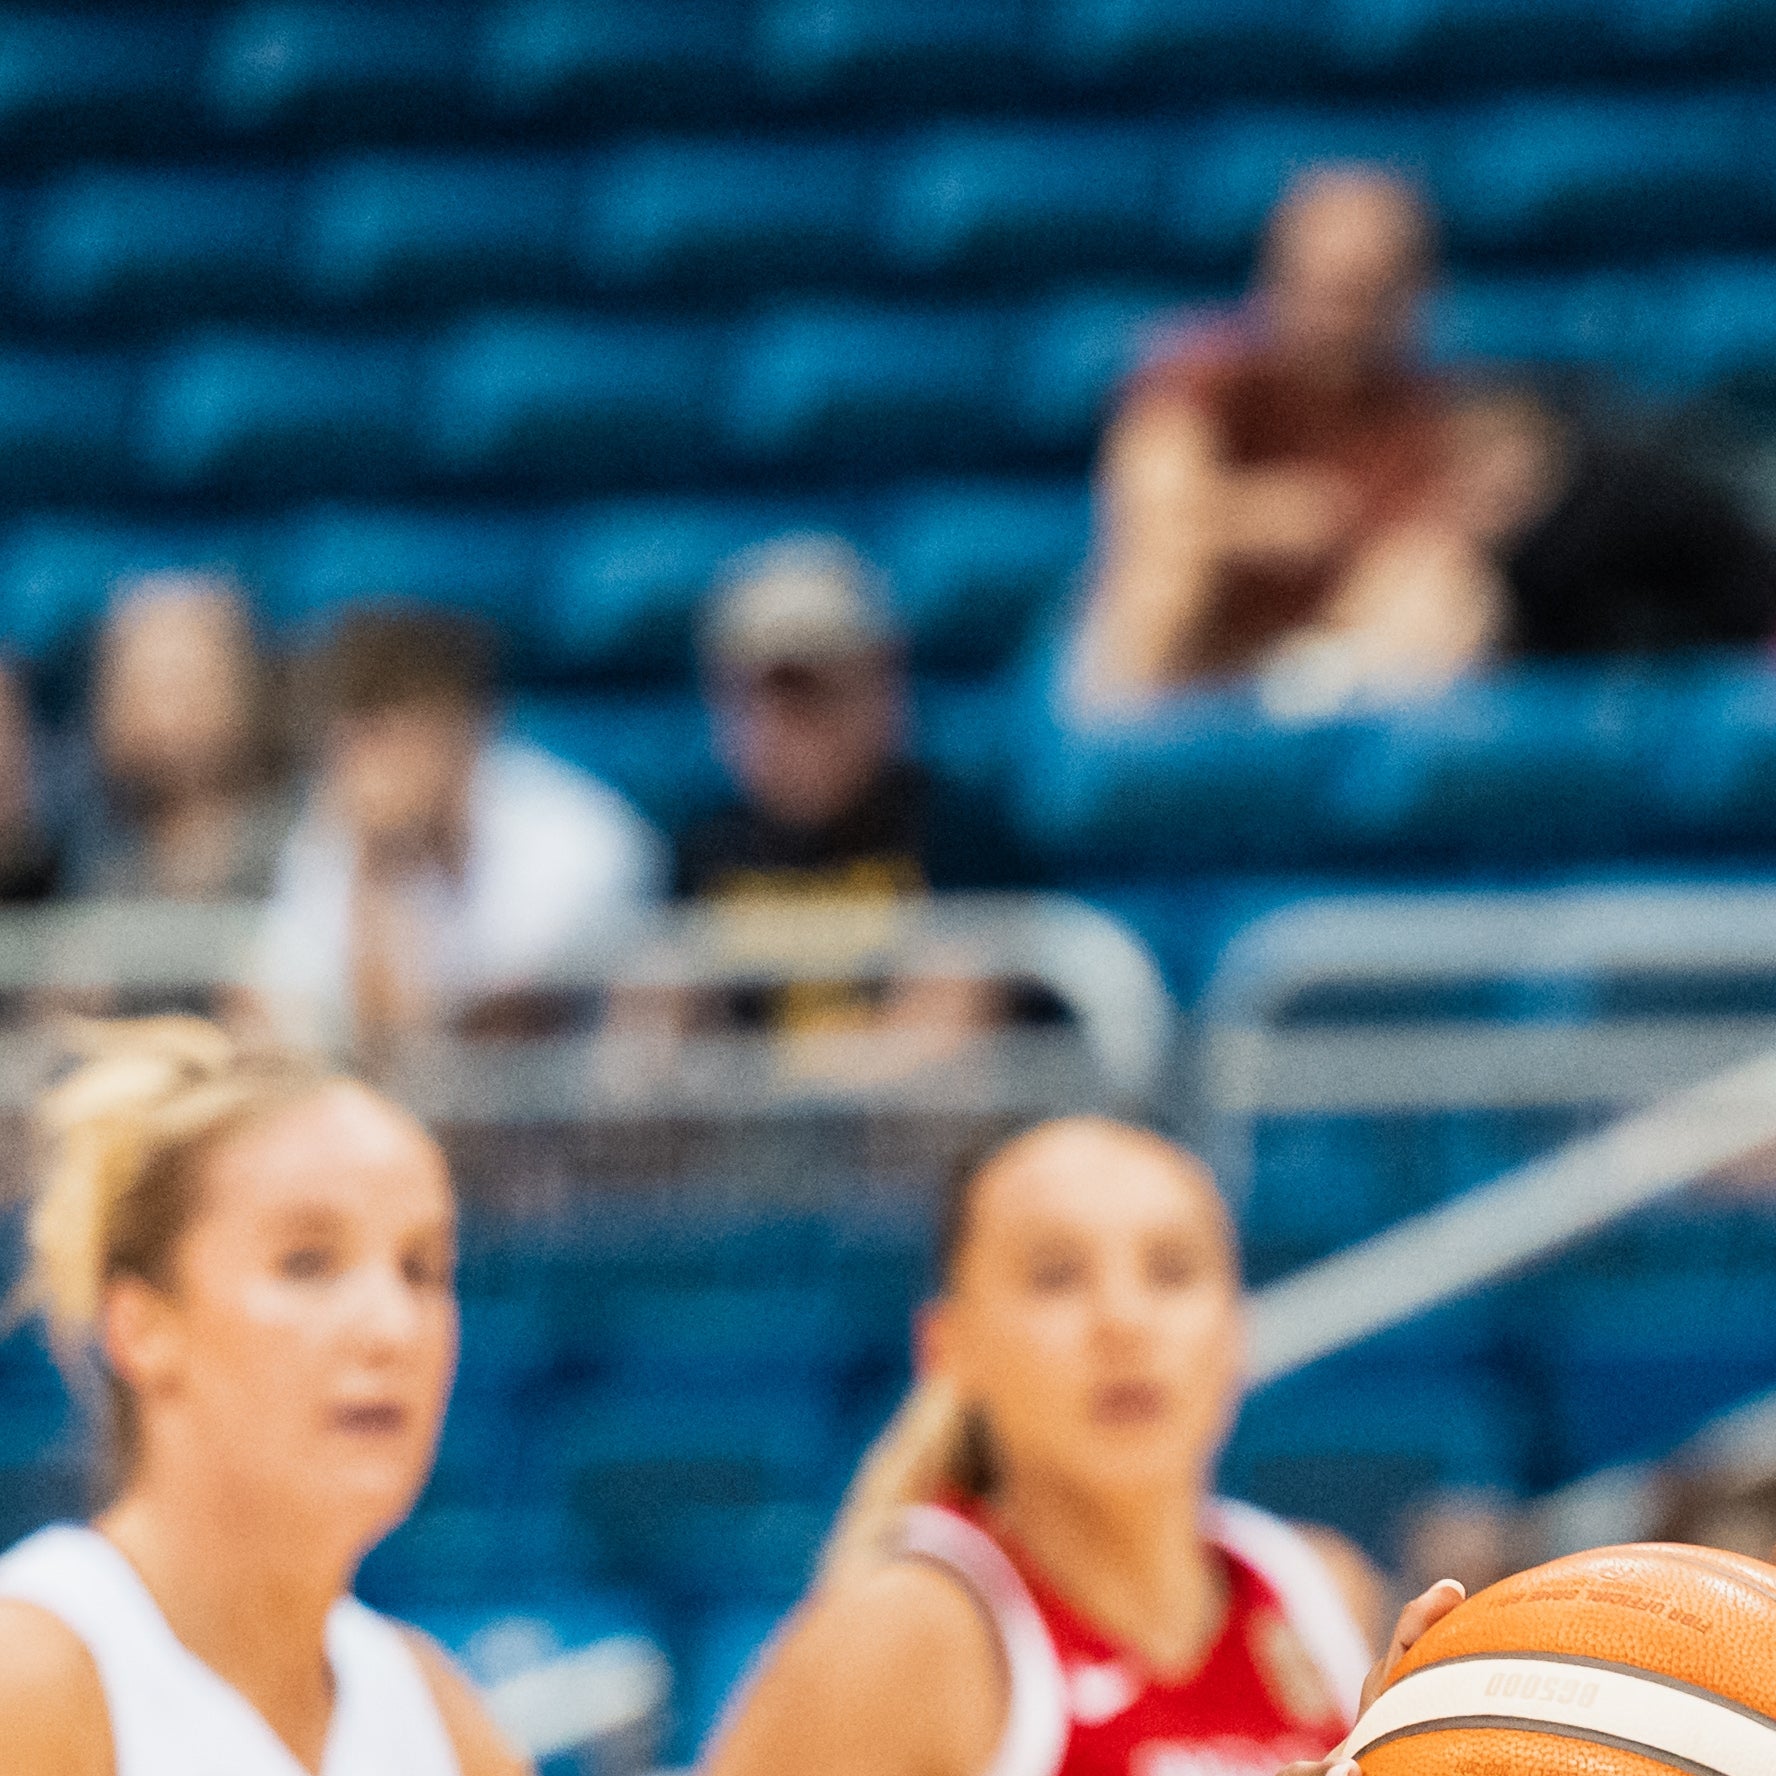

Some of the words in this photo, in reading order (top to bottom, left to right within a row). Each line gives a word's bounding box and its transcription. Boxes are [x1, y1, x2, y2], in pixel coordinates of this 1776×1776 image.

[1587, 1589, 1666, 1614] OFFICIAL
[1668, 1608, 1714, 1634] FIBA
[1484, 1672, 1600, 1709] BG5000
